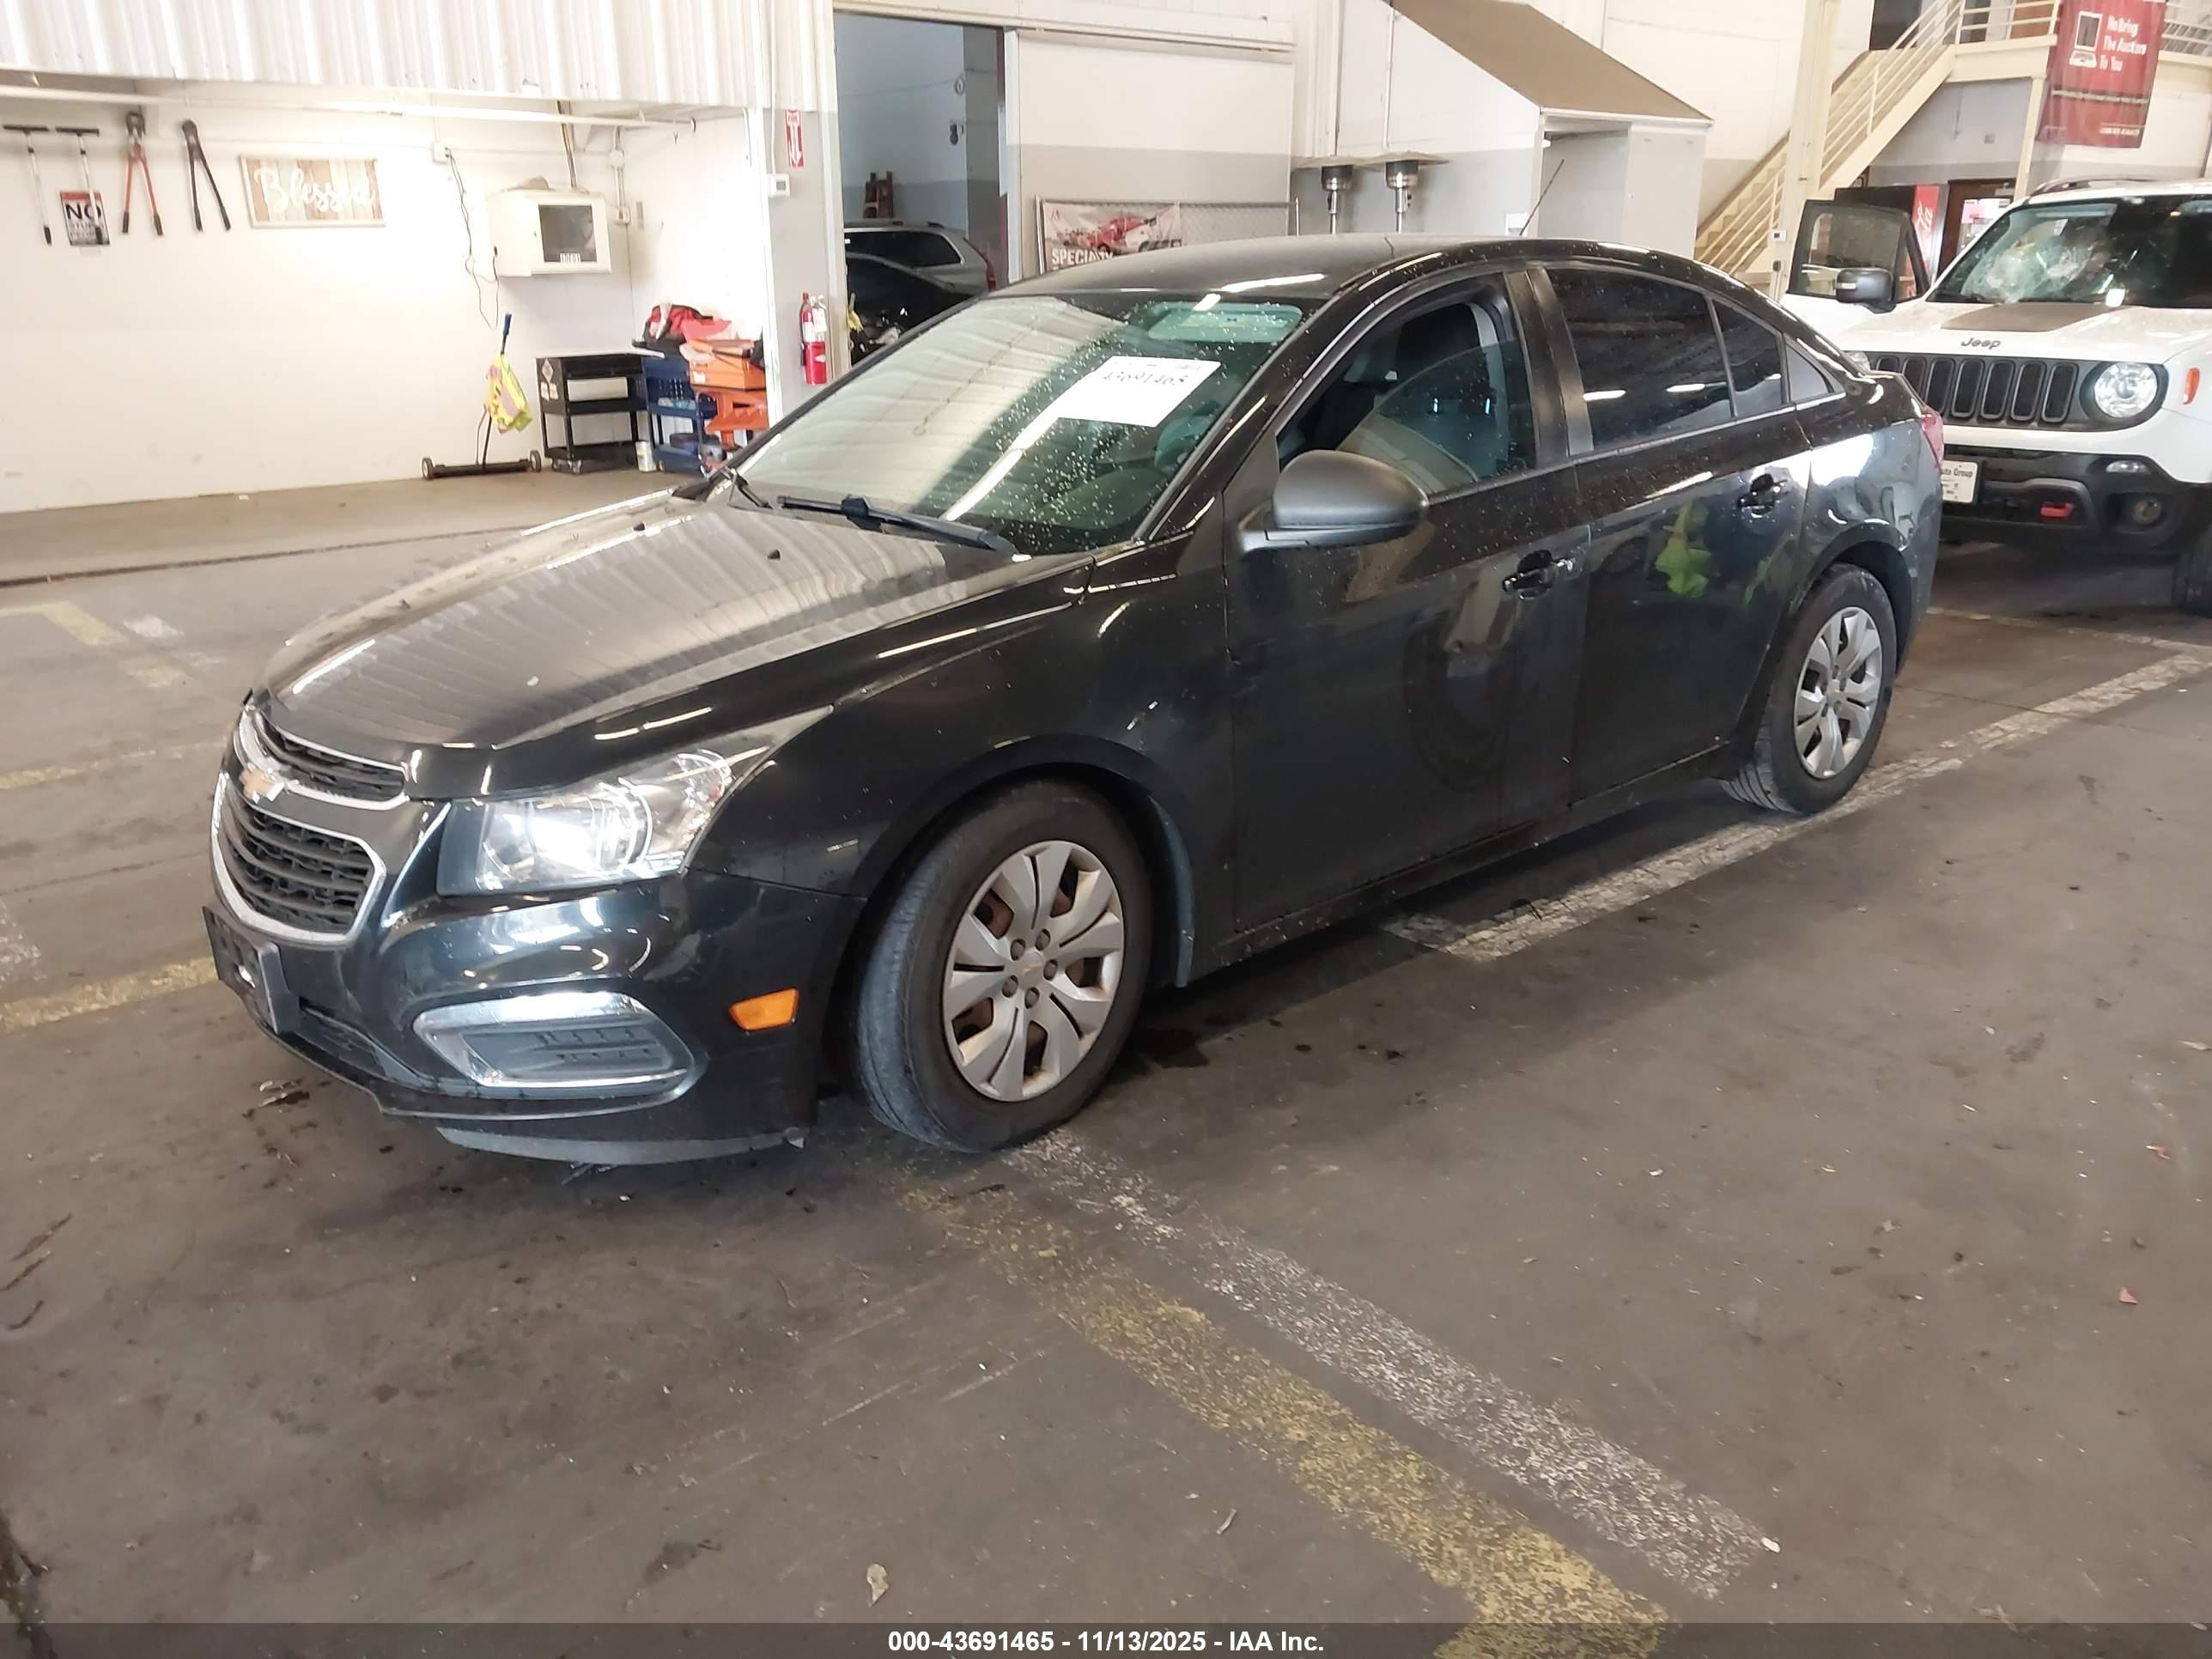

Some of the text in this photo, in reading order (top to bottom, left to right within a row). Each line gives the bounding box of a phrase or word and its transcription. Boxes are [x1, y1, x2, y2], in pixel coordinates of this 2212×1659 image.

[2104, 35, 2147, 55] The Auction
[2100, 54, 2123, 71] To You
[254, 168, 375, 212] Blessed
[65, 203, 102, 221] NO
[1960, 337, 2002, 350] Jeep
